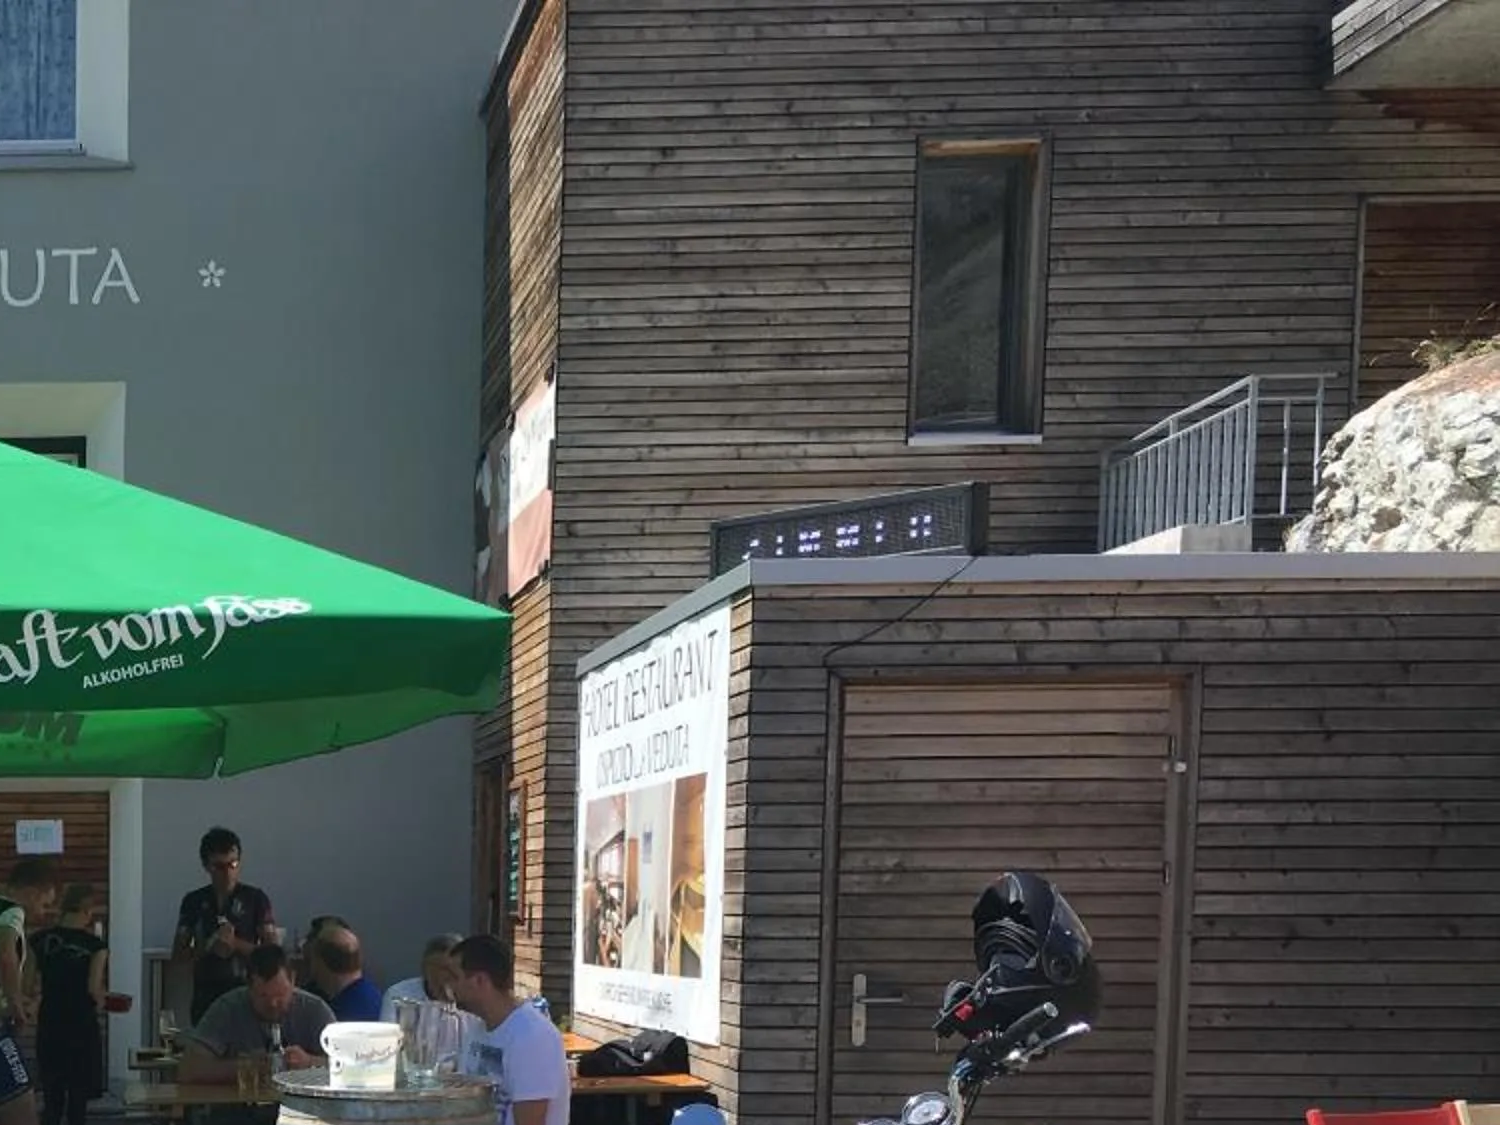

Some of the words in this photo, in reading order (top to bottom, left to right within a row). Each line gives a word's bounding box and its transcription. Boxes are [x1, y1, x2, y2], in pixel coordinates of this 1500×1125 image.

[81, 601, 207, 661] vom
[82, 653, 185, 689] ALKOHOLFREI
[584, 676, 620, 738] HOTEL
[623, 628, 719, 726] RESTAURANT
